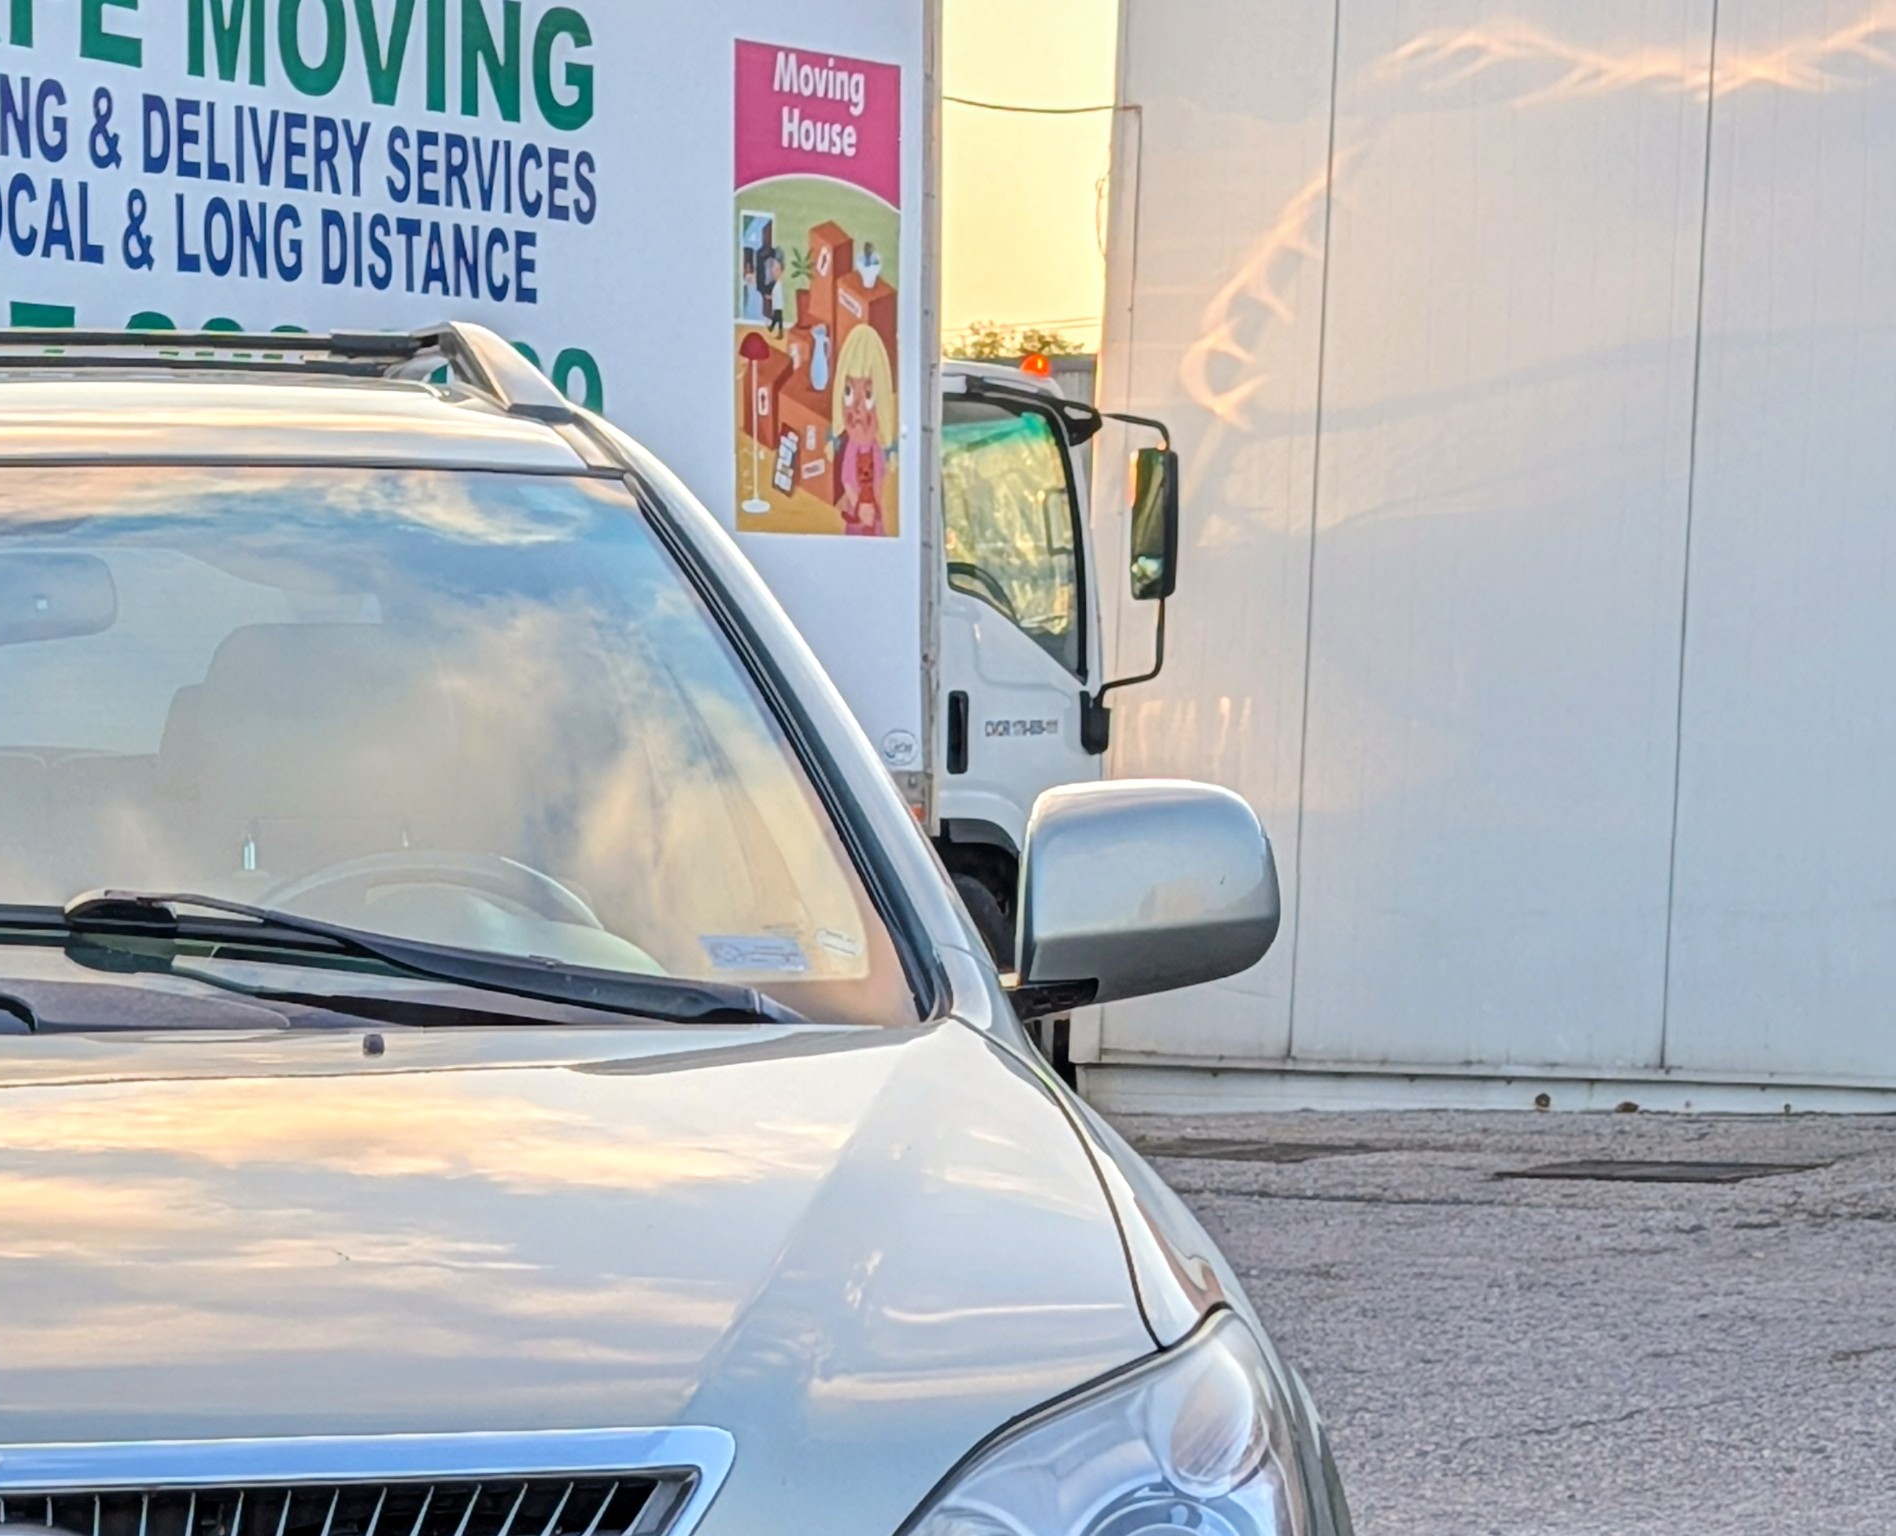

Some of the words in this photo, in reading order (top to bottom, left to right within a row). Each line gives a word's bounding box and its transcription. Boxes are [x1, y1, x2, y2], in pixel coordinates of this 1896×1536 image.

[186, 0, 595, 132] MOVING
[773, 51, 865, 116] Moving
[88, 86, 123, 170] &
[141, 93, 372, 198] DELIVERY
[385, 125, 598, 226] SERVICES
[781, 105, 857, 157] House
[121, 187, 155, 272] &
[174, 192, 303, 283] LONG
[320, 207, 539, 305] DISTANCE
